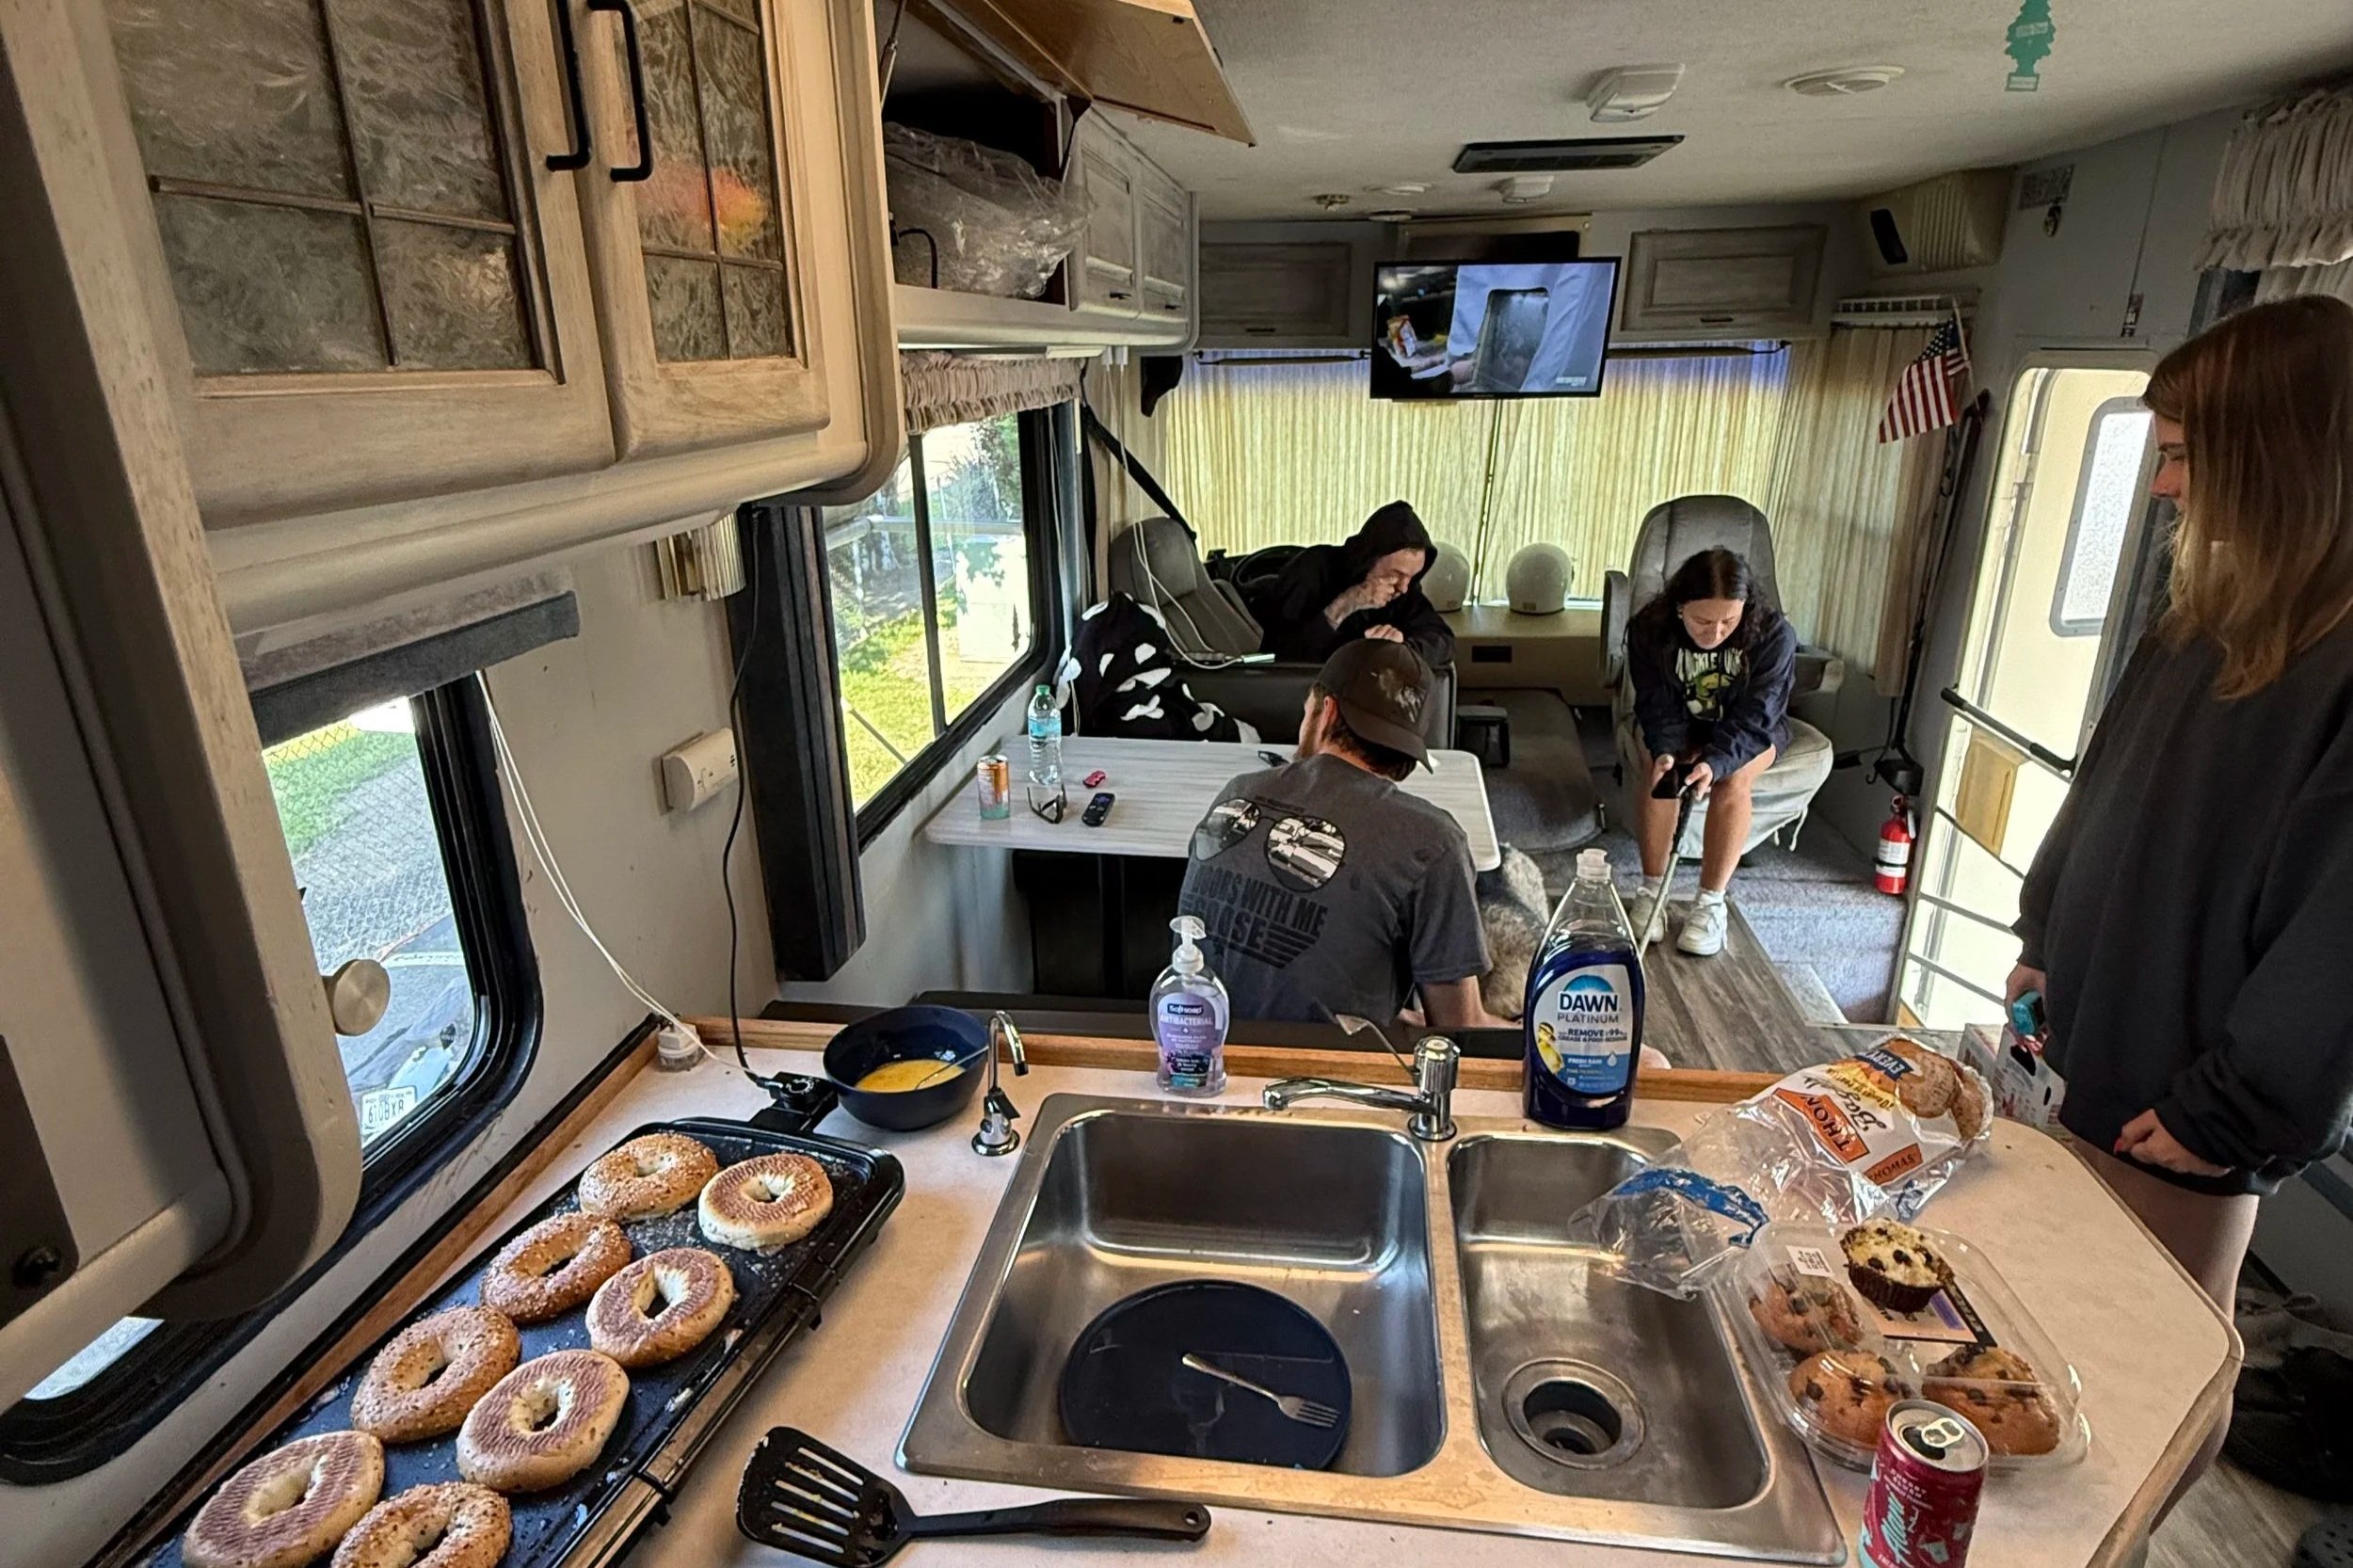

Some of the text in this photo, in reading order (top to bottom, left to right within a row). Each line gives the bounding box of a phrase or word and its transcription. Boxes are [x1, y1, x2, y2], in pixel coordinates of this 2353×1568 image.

[1241, 877, 1294, 924] WITH
[1290, 897, 1329, 937] ME
[1169, 1004, 1203, 1015] Softsoap
[1560, 993, 1618, 1012] DAWN
[1160, 1015, 1213, 1025] ANTIBACTERIAL
[1558, 1013, 1619, 1024] PLATINUM
[1568, 1028, 1604, 1037] REMOVE
[1859, 1050, 1906, 1075] EVERY
[1870, 1154, 1915, 1180] HOMAS
